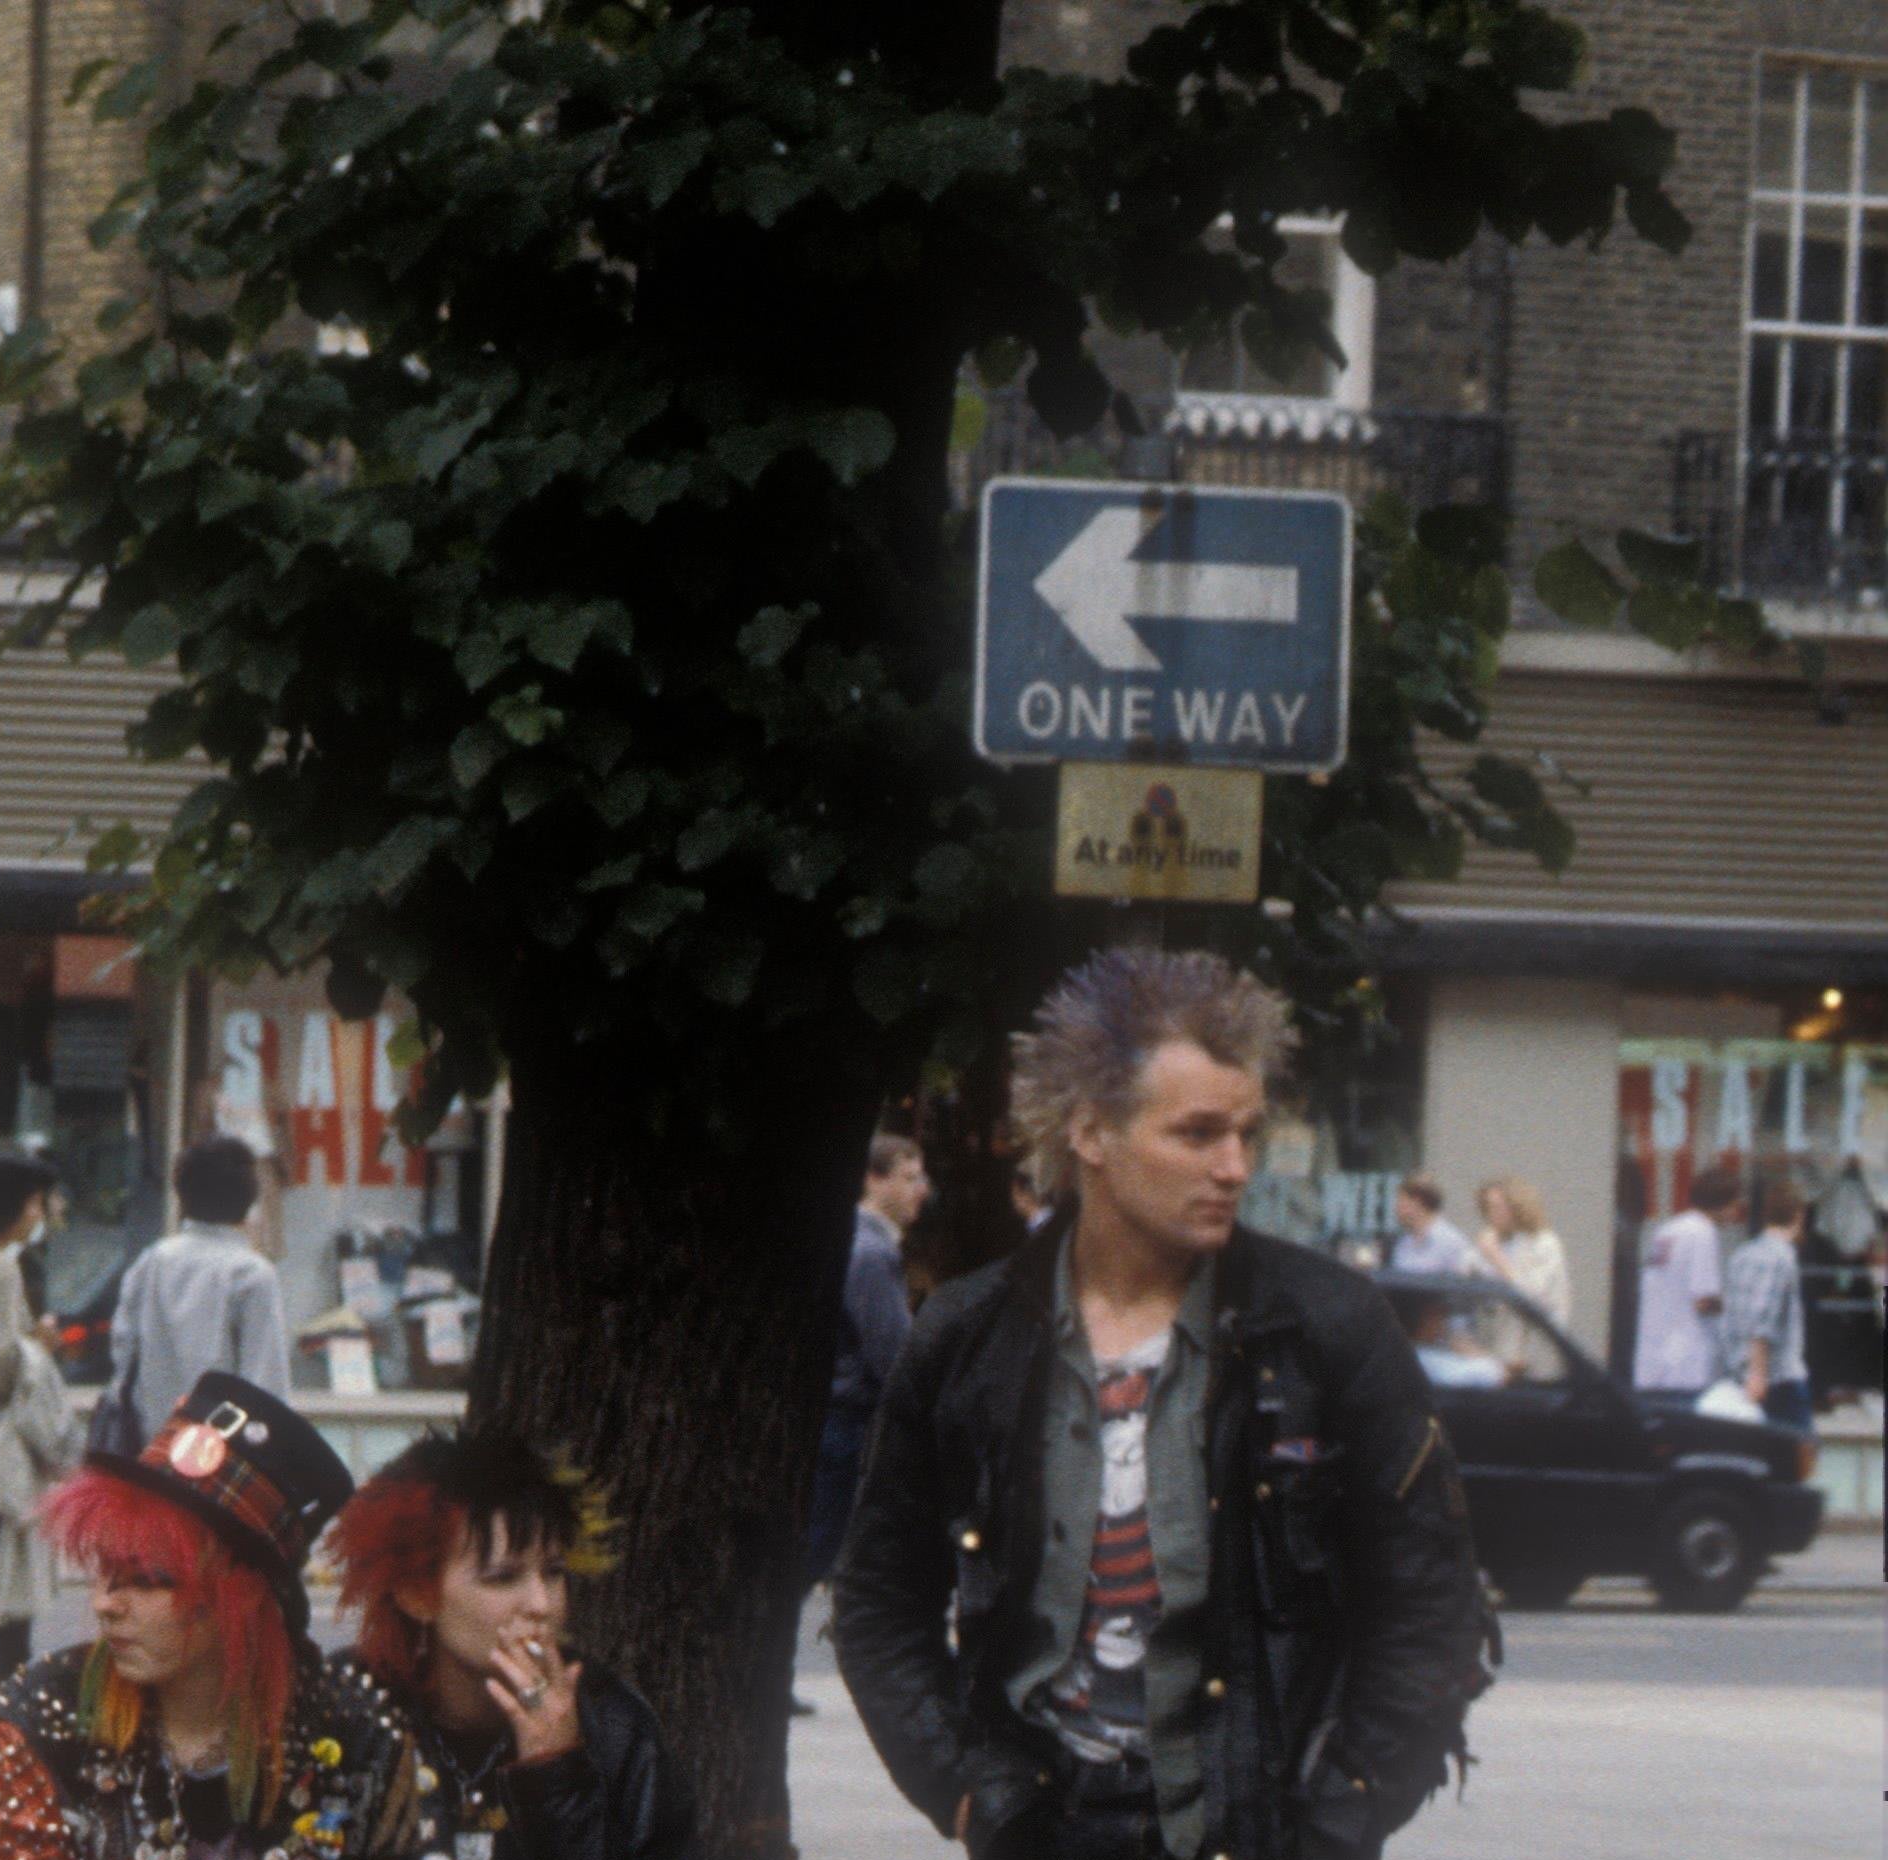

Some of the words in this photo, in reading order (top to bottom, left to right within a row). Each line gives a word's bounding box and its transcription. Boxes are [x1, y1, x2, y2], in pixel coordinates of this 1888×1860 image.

[1018, 680, 1155, 741] ONE
[1173, 688, 1306, 746] WAY
[1075, 836, 1109, 867] At
